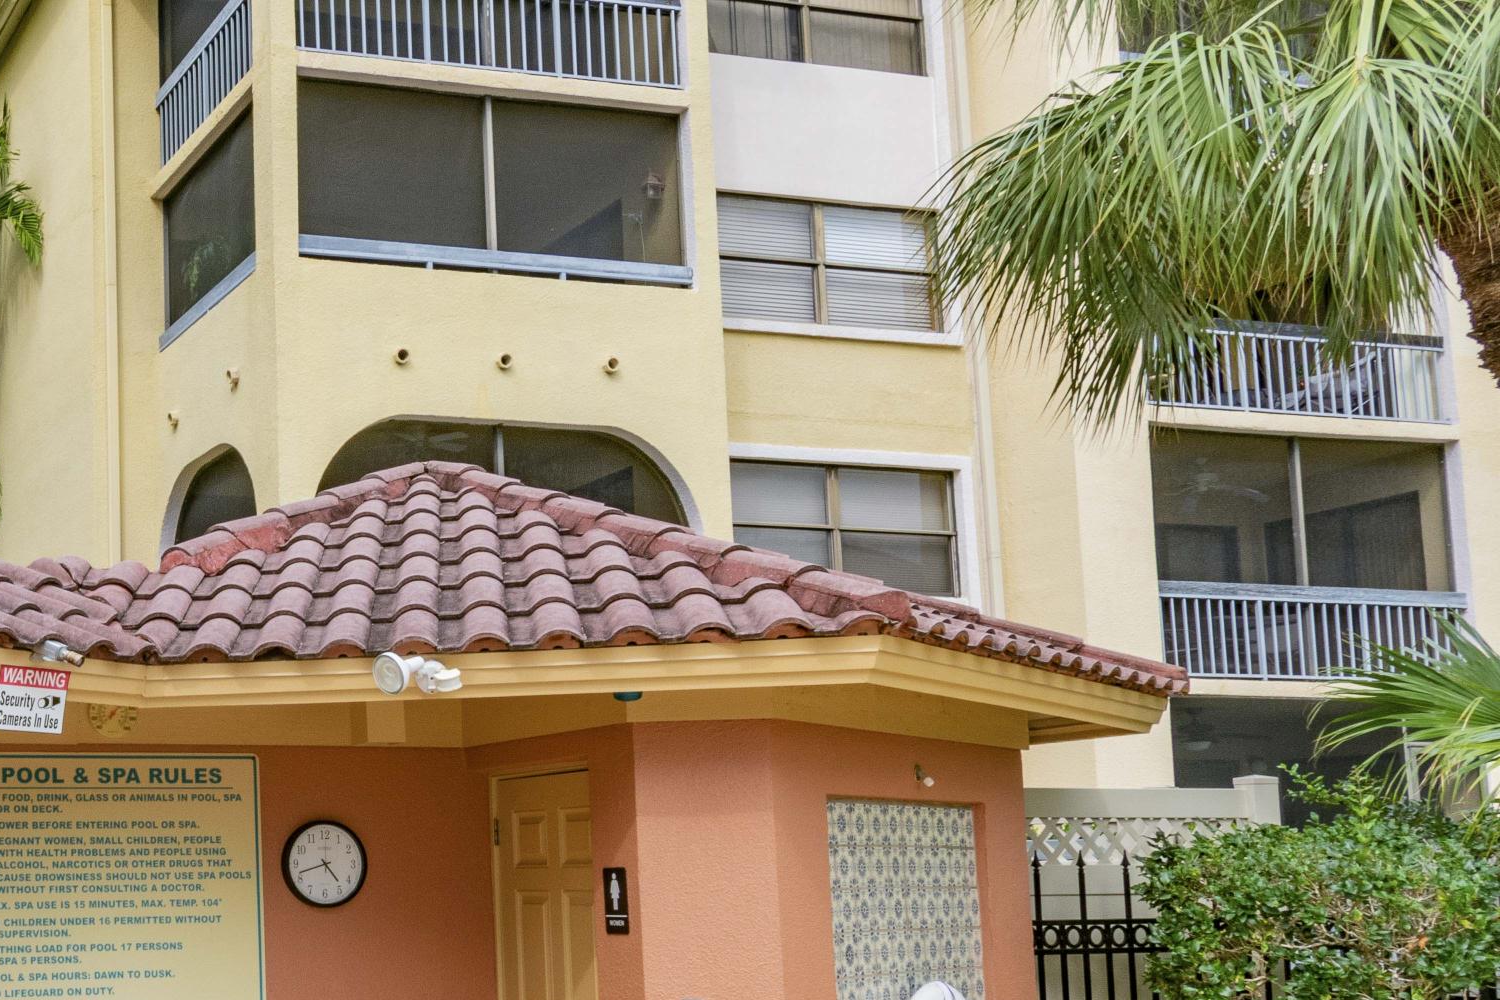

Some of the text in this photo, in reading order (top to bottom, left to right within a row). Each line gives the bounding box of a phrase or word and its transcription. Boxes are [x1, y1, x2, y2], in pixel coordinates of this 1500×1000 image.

[3, 667, 67, 688] WARNING
[0, 691, 35, 711] Security
[34, 713, 41, 727] In
[44, 714, 58, 729] Use
[1, 768, 222, 784] POOL & SPA RULES
[2, 794, 33, 803] FOOD,
[37, 794, 72, 803] DRINK,
[75, 794, 109, 802] GLASS
[112, 794, 126, 802] OR
[129, 794, 174, 802] ANIMALS
[178, 794, 187, 802] IN
[191, 794, 220, 803] POOL,
[223, 794, 242, 802] SPA
[32, 805, 63, 813] DECK.
[32, 821, 72, 829] BEFORE
[76, 821, 127, 829] ENTERING
[131, 821, 158, 829] POOL
[161, 821, 175, 829] OR
[178, 821, 200, 829] SPA.
[307, 834, 315, 843] 11
[320, 830, 330, 839] 12
[44, 837, 86, 846] WOMEN,
[90, 836, 123, 844] SMALL
[127, 836, 181, 846] CHILDREN,
[184, 836, 221, 844] PEOPLE
[337, 835, 340, 844] 1
[71, 848, 126, 856] PROBLEMS
[129, 848, 149, 856] AND
[153, 848, 192, 856] PEOPLE
[195, 847, 226, 855] USING
[297, 845, 306, 855] 10
[346, 844, 351, 854] 2
[52, 860, 111, 869] NARCOTICS
[114, 860, 128, 868] OR
[132, 860, 165, 868] OTHER
[207, 859, 232, 867] THAT
[293, 859, 298, 868] 9
[351, 860, 355, 869] 3
[35, 872, 102, 881] DROWSINESS
[106, 872, 147, 880] SHOULD
[150, 872, 171, 880] NOT
[197, 871, 216, 879] SPA
[219, 871, 251, 879] POOLS
[298, 874, 303, 883] 8
[346, 875, 351, 884] 4
[49, 885, 79, 893] FIRST
[82, 884, 148, 892] CONSULTING
[151, 884, 158, 892] A
[161, 884, 204, 892] DOCTOR.
[308, 885, 313, 894] 7
[337, 885, 342, 894] 5
[322, 889, 327, 898] 6
[15, 901, 33, 909] SPA
[37, 901, 57, 909] USE
[60, 901, 70, 909] IS
[75, 901, 85, 909] 15
[89, 900, 137, 910] MINUTES,
[141, 900, 165, 908] MAX.
[170, 899, 198, 907] TEMP.
[4, 918, 56, 926] CHILDREN
[60, 917, 96, 925] UNDER
[100, 917, 110, 925] 16
[113, 916, 172, 924] PERMITTED
[175, 915, 221, 924] WITHOUT
[66, 944, 87, 952] FOR
[90, 944, 117, 952] POOL
[121, 943, 132, 951] 17
[136, 943, 183, 951] PERSONS
[0, 957, 17, 965] SPA
[30, 956, 81, 964] PERSONS.
[18, 973, 26, 981] &
[30, 973, 49, 981] SPA
[52, 972, 90, 980] HOURS:
[94, 971, 124, 979] DAWN
[127, 971, 141, 979] TO
[145, 970, 175, 978] DUSK.
[5, 988, 63, 997] LIFEGUARD
[67, 988, 82, 996] ON
[86, 988, 114, 996] DUTY.
